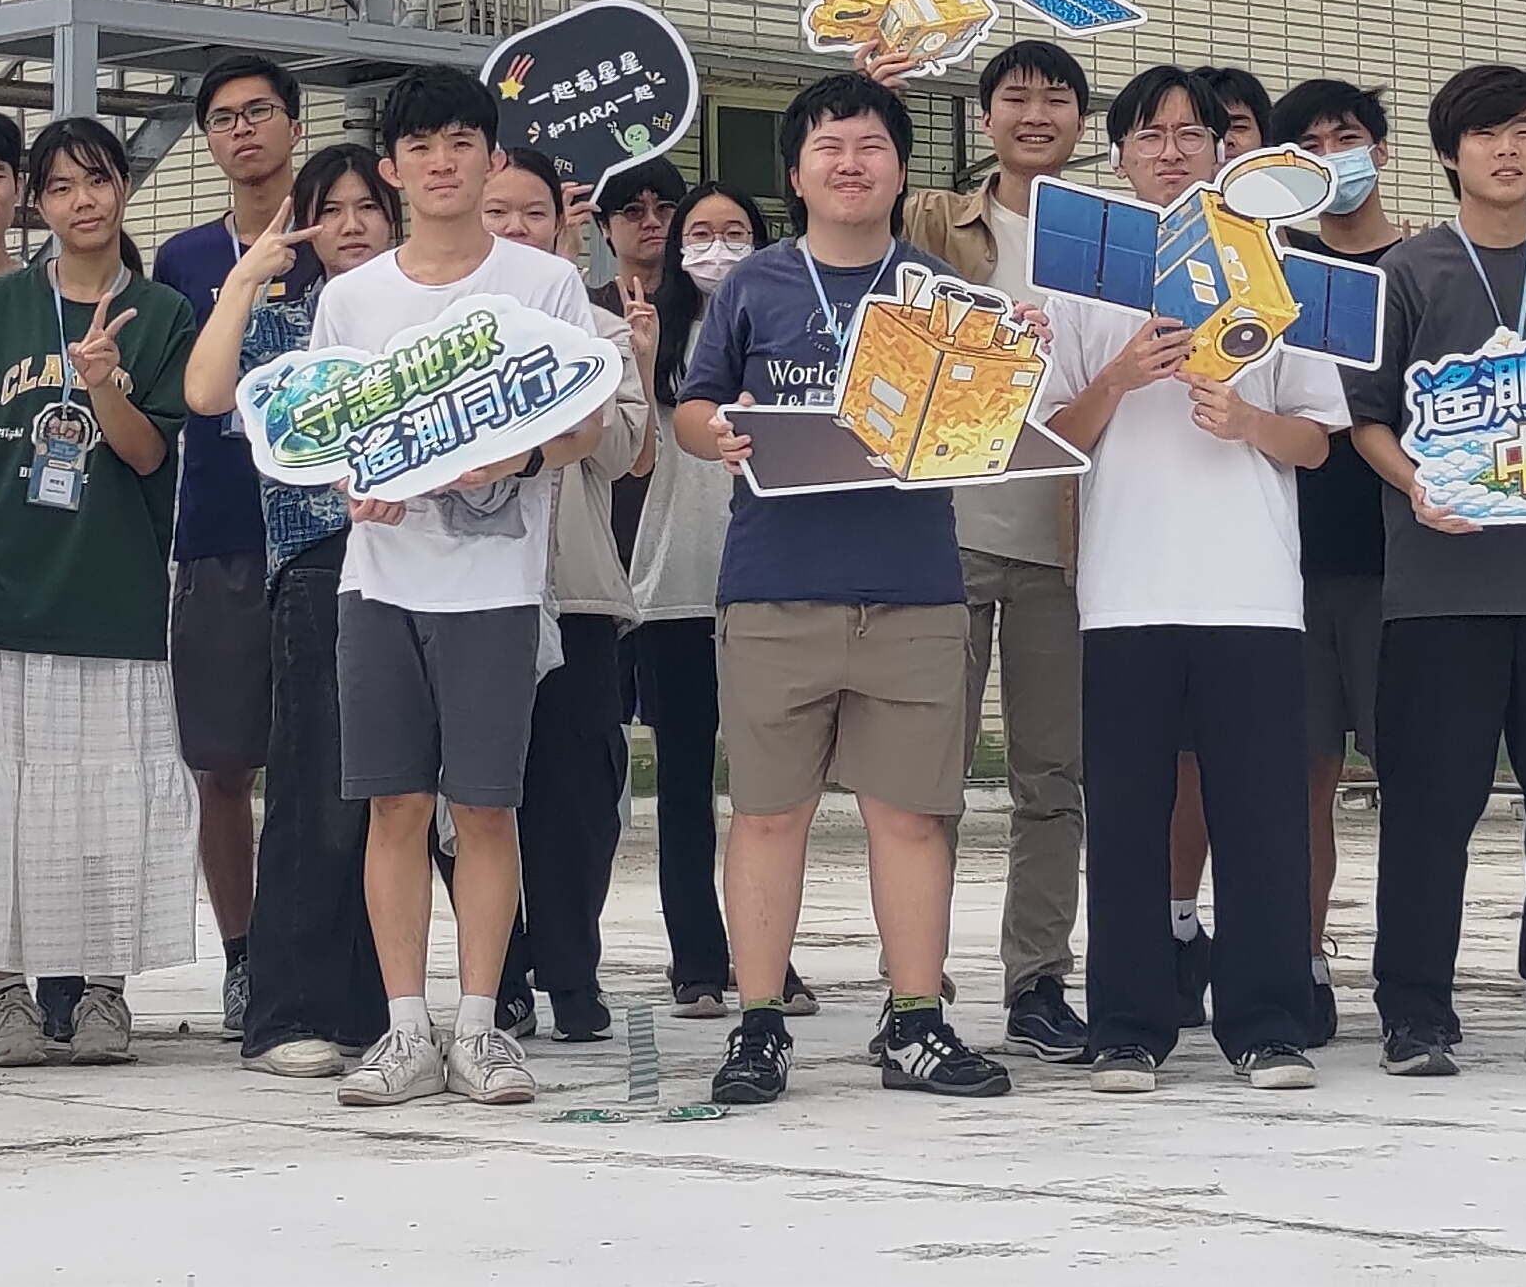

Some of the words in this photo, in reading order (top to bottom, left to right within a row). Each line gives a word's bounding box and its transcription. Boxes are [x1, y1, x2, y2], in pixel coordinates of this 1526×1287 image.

[527, 51, 644, 106] 一起看星星
[292, 310, 504, 445] 守護地球
[346, 346, 559, 492] 遙測同行
